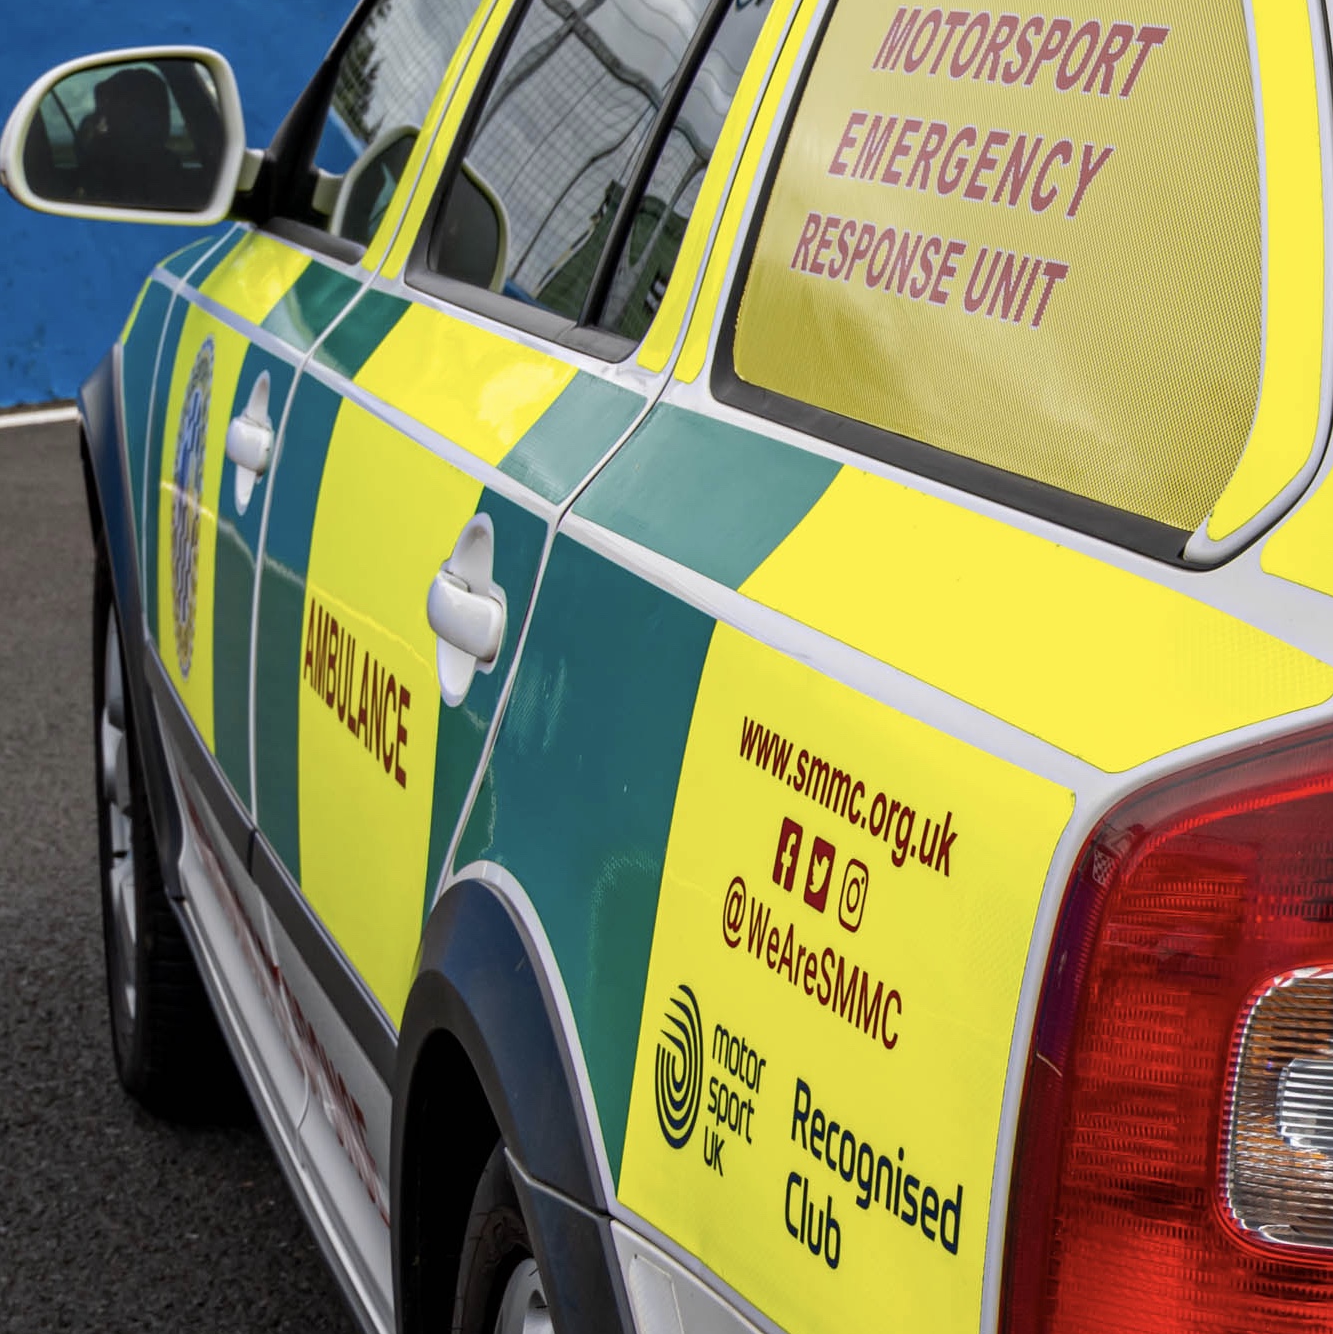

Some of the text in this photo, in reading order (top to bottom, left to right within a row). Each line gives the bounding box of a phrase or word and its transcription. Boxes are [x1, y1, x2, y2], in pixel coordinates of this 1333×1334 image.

[871, 6, 1170, 98] MOTORSPORT
[826, 110, 1115, 221] EMERGENCY
[790, 212, 1070, 329] RESPONSE UNIT
[304, 599, 411, 789] AMBULANCE
[739, 716, 958, 877] www.smmc.org.uk
[722, 876, 902, 1050] @WeAreSMMC
[706, 1076, 755, 1145] sport
[711, 1023, 767, 1094] motor
[703, 1126, 726, 1177] UK
[791, 1077, 963, 1255] Recognised
[785, 1171, 842, 1269] Club
